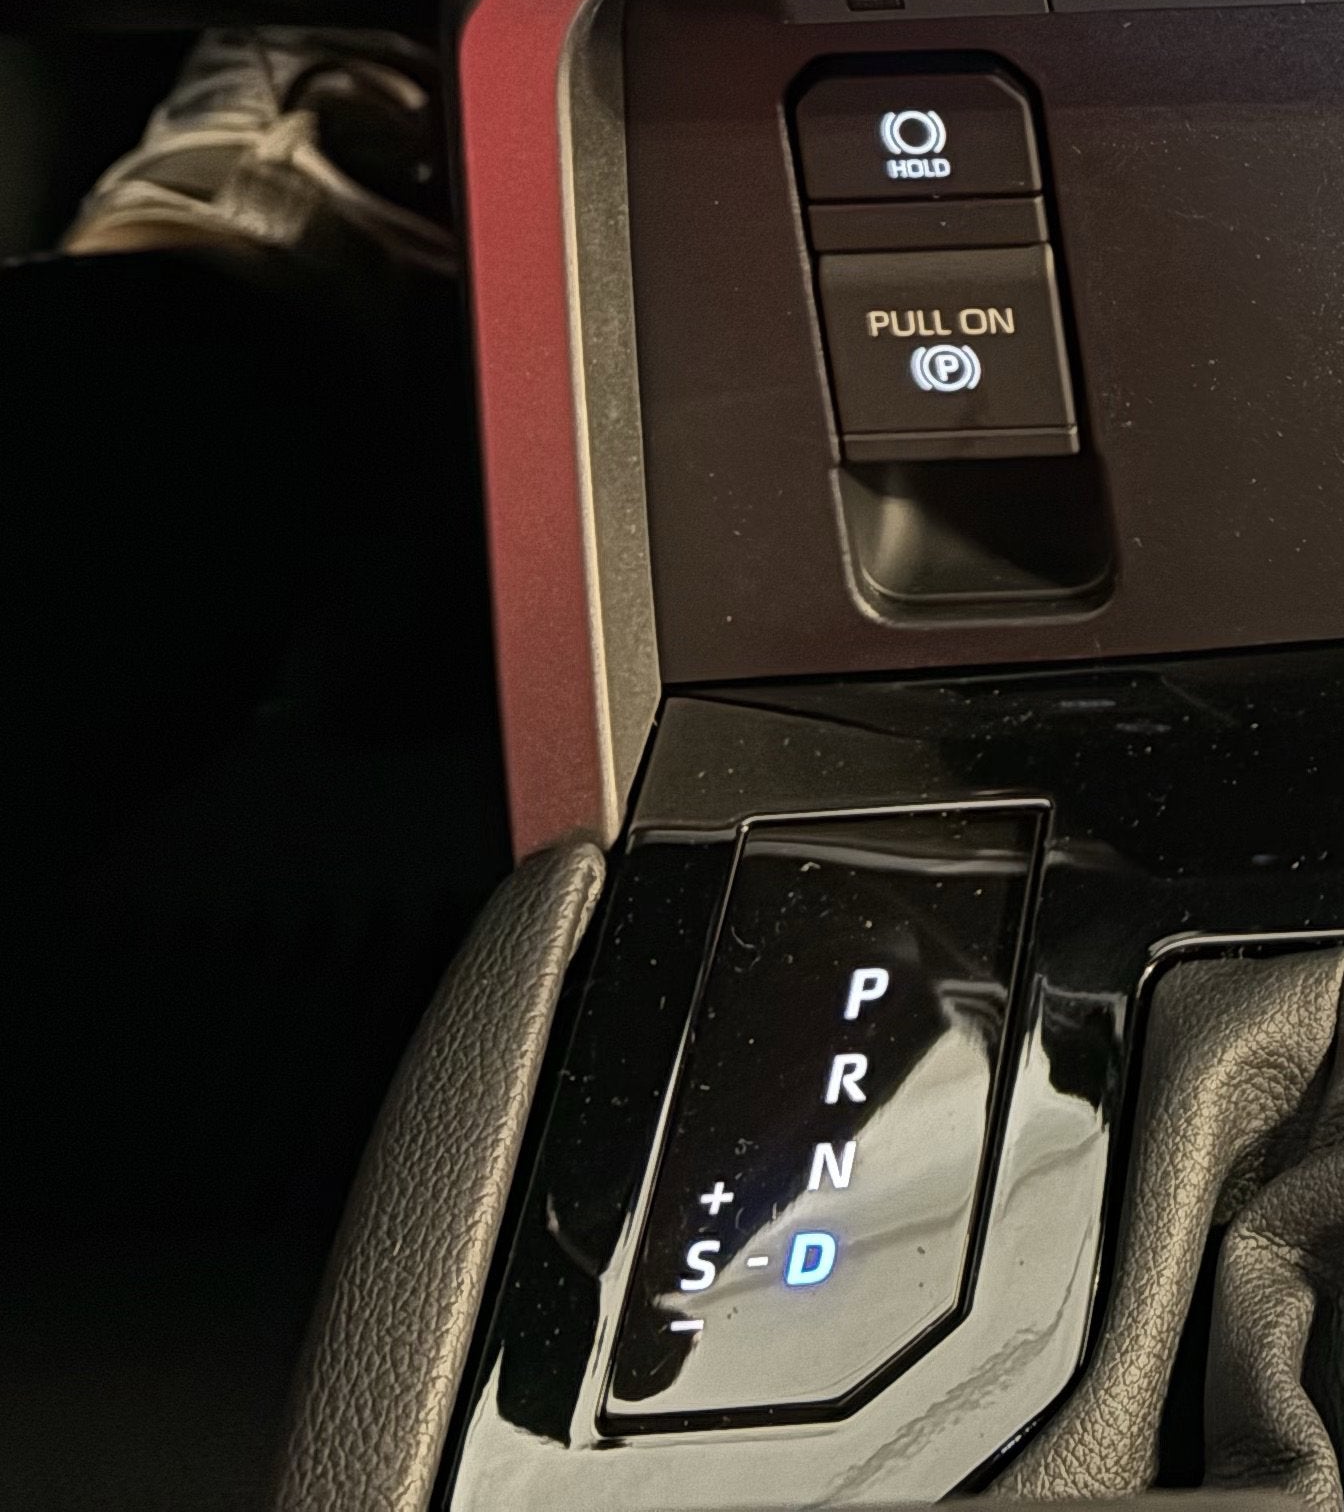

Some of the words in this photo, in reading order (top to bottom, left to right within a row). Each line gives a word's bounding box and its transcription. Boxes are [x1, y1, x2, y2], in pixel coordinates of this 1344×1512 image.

[885, 157, 952, 179] HOLD
[866, 309, 952, 338] PULL
[958, 307, 1016, 334] ON
[843, 967, 890, 1021] P
[824, 1052, 869, 1106] R
[807, 1140, 857, 1191] N
[679, 1239, 721, 1292] S
[784, 1231, 838, 1287] D
